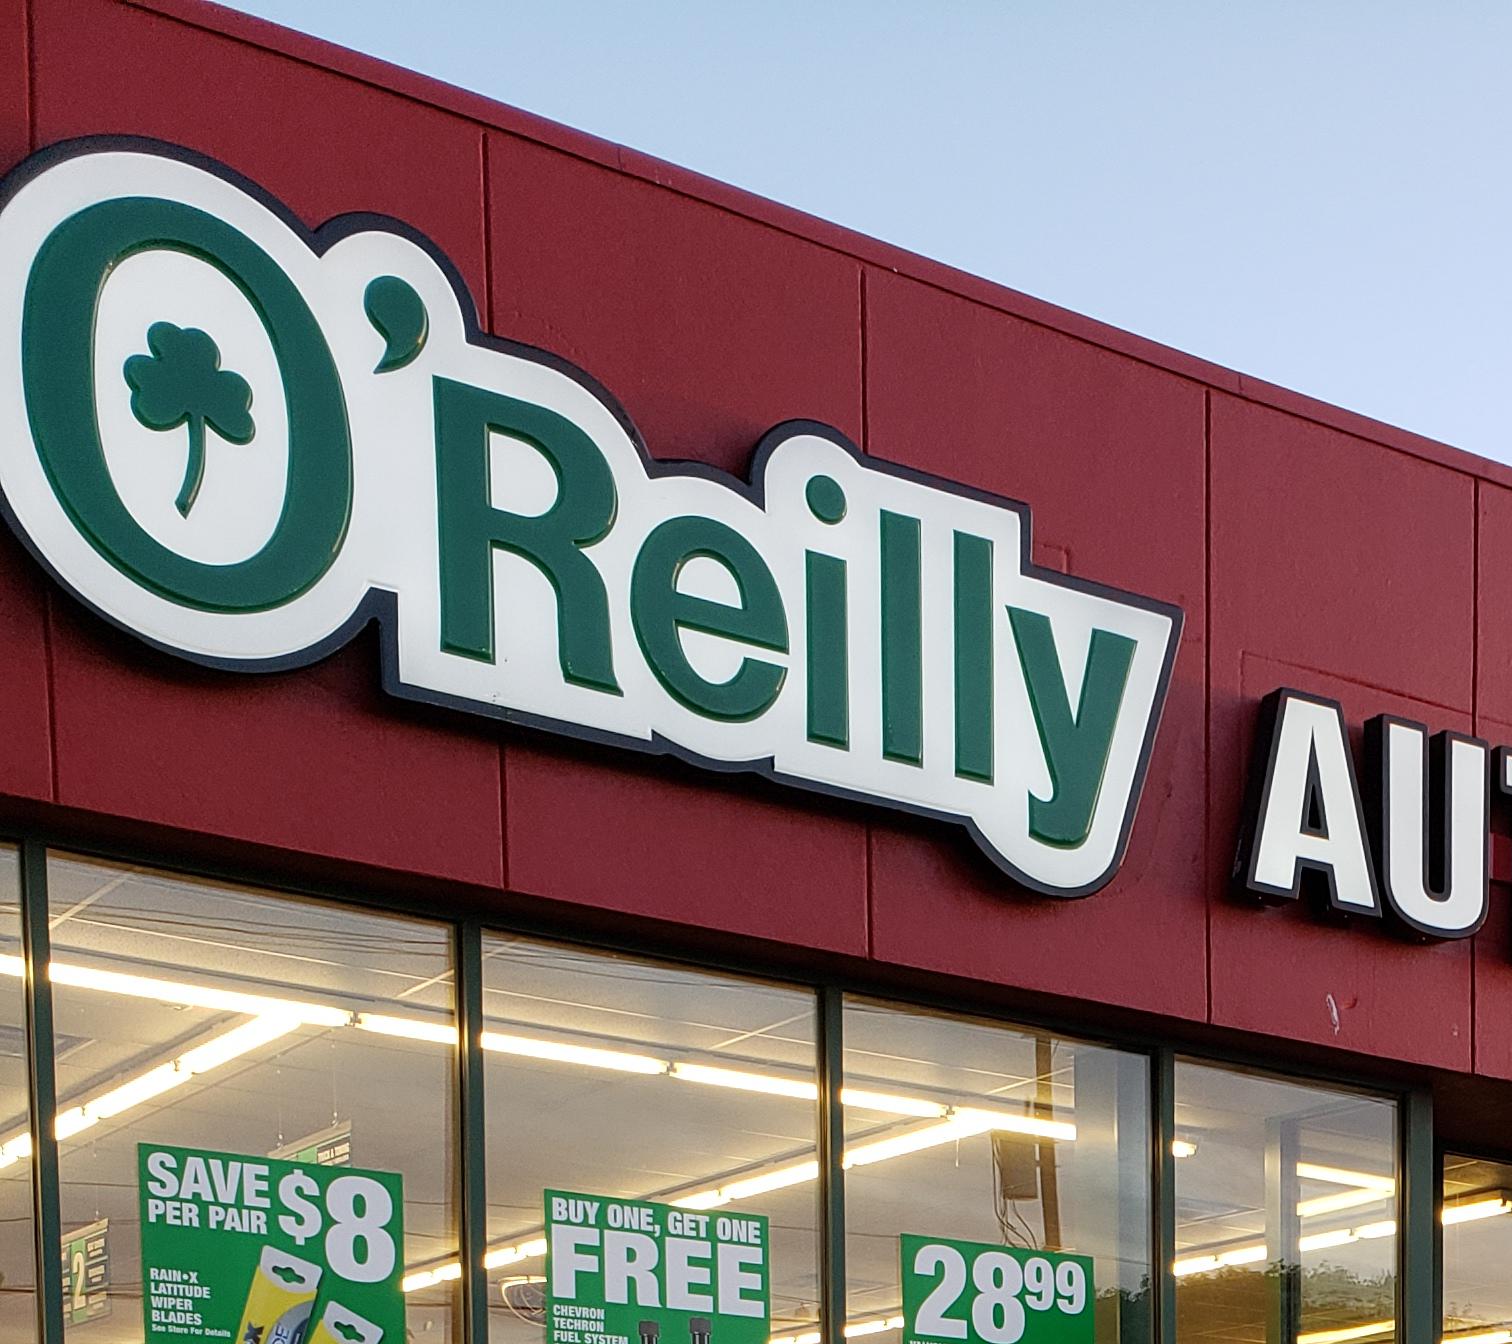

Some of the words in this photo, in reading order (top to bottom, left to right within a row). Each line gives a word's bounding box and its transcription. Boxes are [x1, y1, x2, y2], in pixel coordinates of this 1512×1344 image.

[21, 195, 1138, 849] O'Reilly
[147, 1152, 271, 1208] SAVE
[278, 1169, 396, 1283] $8
[148, 1199, 200, 1227] PER
[208, 1205, 268, 1234] PAIR
[551, 1197, 600, 1224] BUY
[607, 1204, 661, 1237] ONE,
[668, 1211, 710, 1238] GET
[716, 1217, 761, 1244] ONE
[551, 1223, 765, 1318] FREE
[73, 1251, 86, 1310] 2
[150, 1282, 211, 1299] LATITUDE
[151, 1296, 193, 1311] WIPER
[553, 1304, 605, 1320] CHEVRON
[151, 1310, 202, 1325] BLADES
[553, 1317, 605, 1332] TECHRON
[152, 1324, 166, 1333] See
[168, 1325, 188, 1335] Store
[190, 1327, 203, 1336] For
[205, 1327, 231, 1338] Details
[554, 1331, 581, 1343] FUEL
